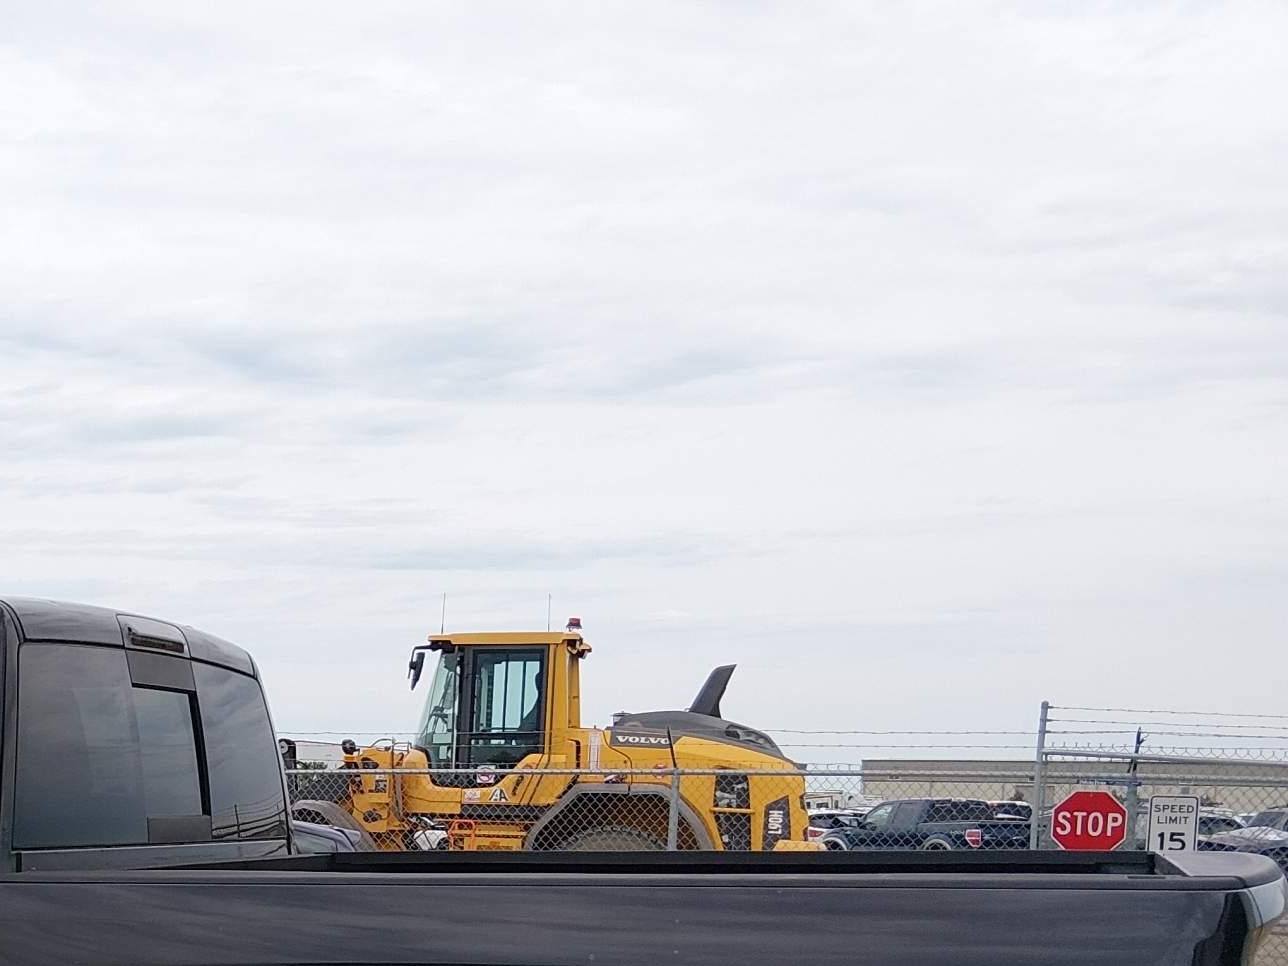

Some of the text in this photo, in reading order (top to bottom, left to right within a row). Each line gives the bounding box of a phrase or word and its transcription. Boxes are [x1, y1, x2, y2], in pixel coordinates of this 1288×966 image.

[616, 735, 671, 745] VOLVO
[1154, 804, 1195, 813] SPEED
[768, 810, 784, 834] L90H
[1055, 811, 1123, 837] STOP
[1157, 815, 1189, 825] LIMIT
[1157, 831, 1186, 851] 15
